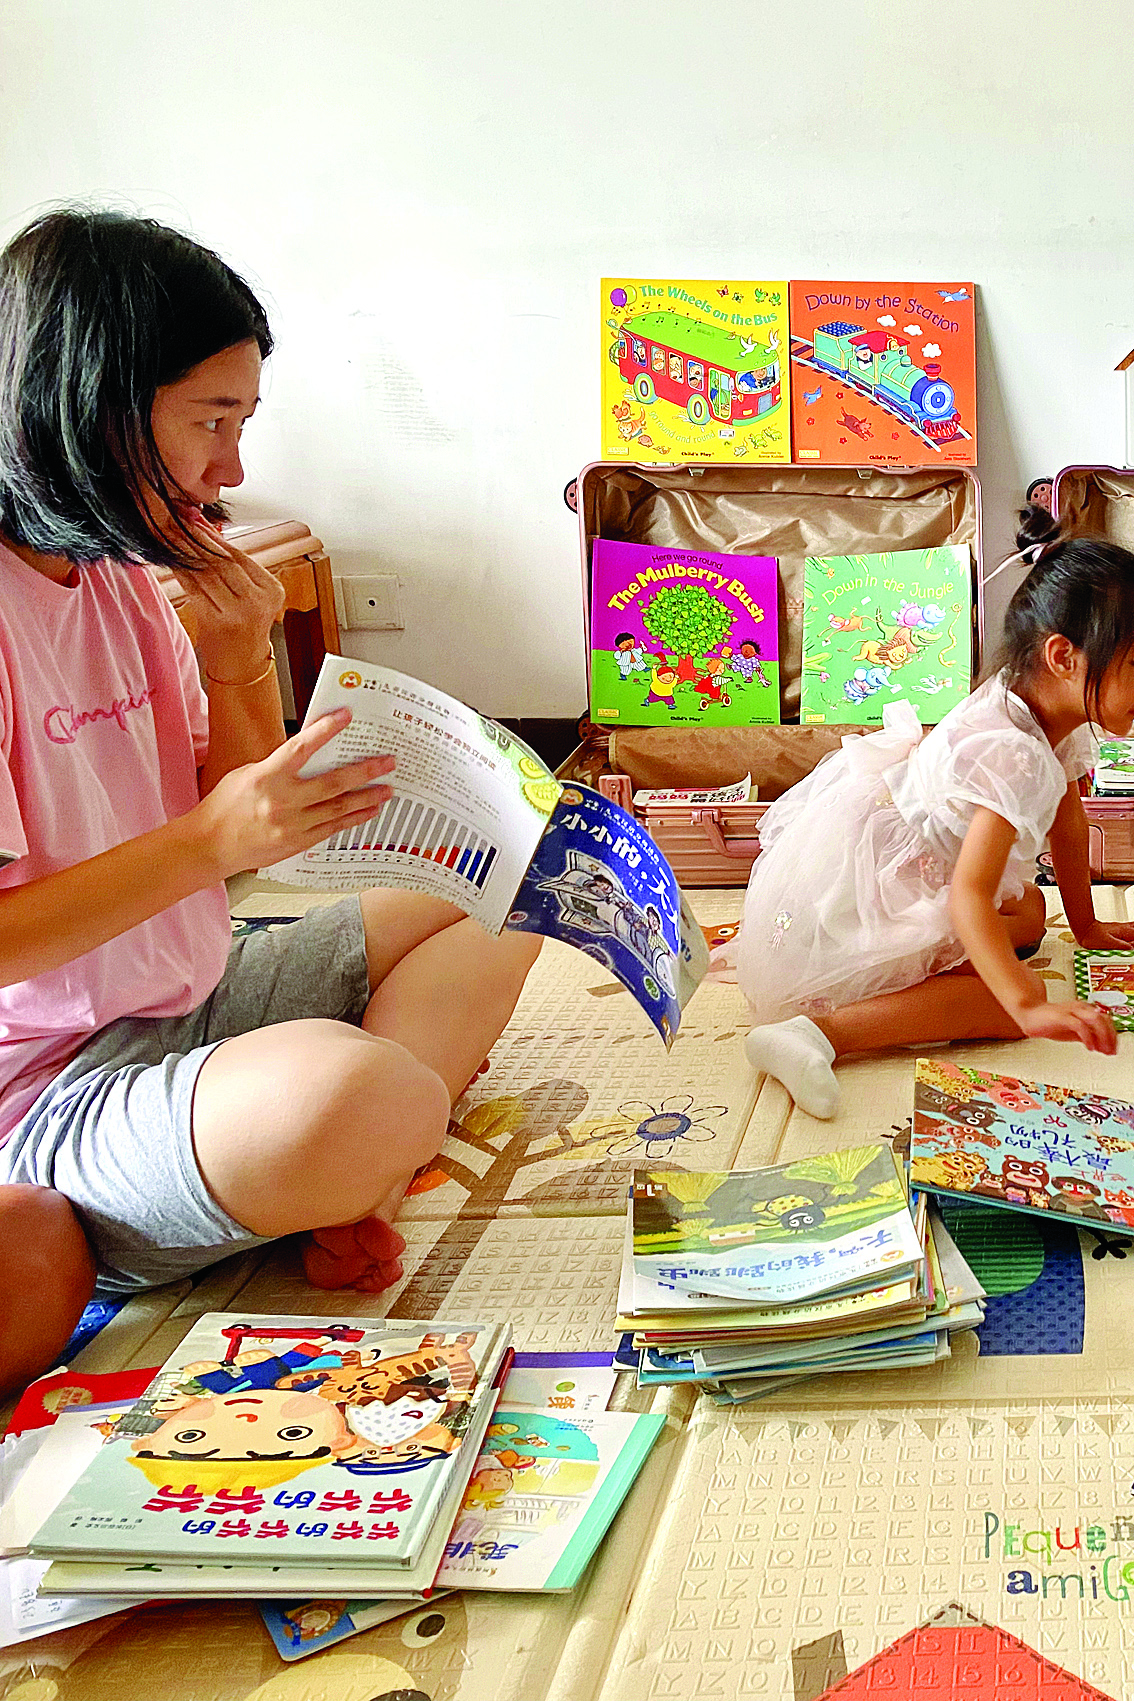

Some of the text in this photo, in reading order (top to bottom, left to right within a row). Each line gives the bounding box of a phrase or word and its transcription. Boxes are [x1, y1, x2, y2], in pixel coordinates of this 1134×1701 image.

[639, 285, 778, 326] The Wheels on the Bus
[805, 293, 960, 333] Down by the Station
[651, 554, 672, 564] Here
[687, 555, 698, 564] go
[698, 556, 724, 570] round
[607, 563, 765, 624] The Mulberry Bush
[821, 573, 954, 606] Down in the Jungle
[141, 1484, 413, 1515] 爷爷的爷爷
[182, 1518, 400, 1541] 爷爷的爷爷的
